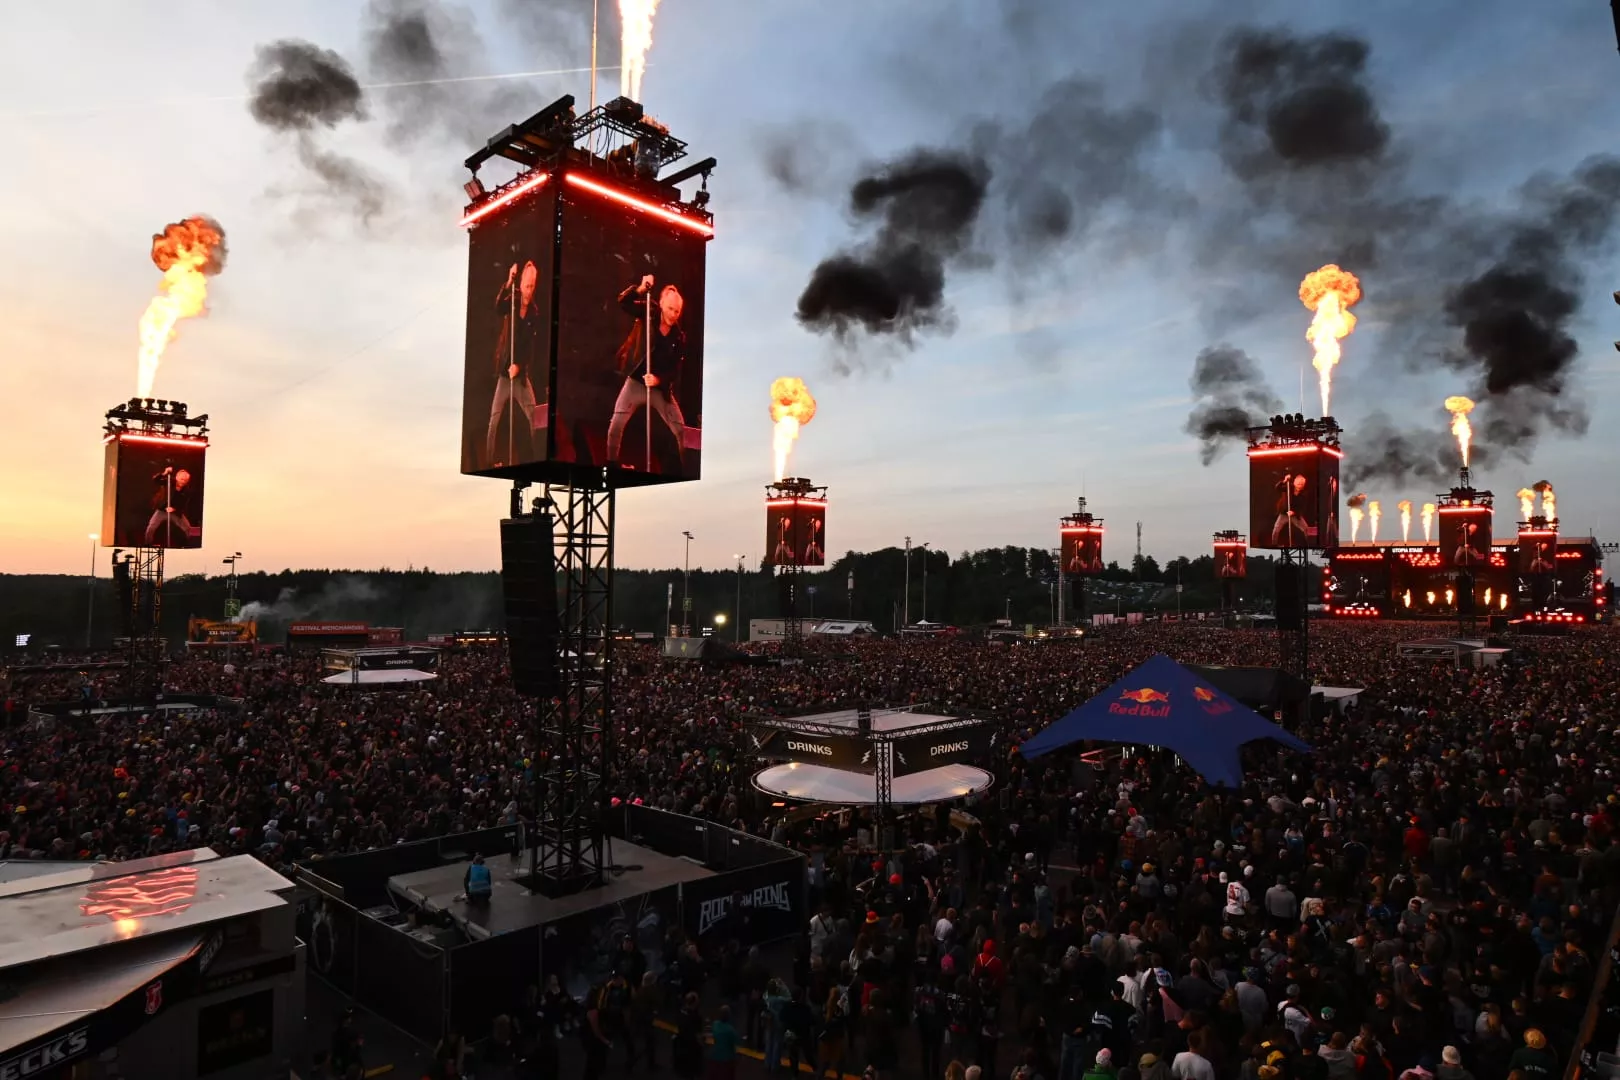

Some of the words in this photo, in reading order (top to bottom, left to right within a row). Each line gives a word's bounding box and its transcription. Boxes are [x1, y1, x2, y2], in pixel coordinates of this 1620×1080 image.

[1108, 702, 1140, 716] Red
[1140, 704, 1171, 717] Bull
[787, 741, 833, 756] DRINKS
[930, 740, 969, 757] DRINKS
[753, 881, 792, 911] RING
[0, 1029, 88, 1080] ECK'S
